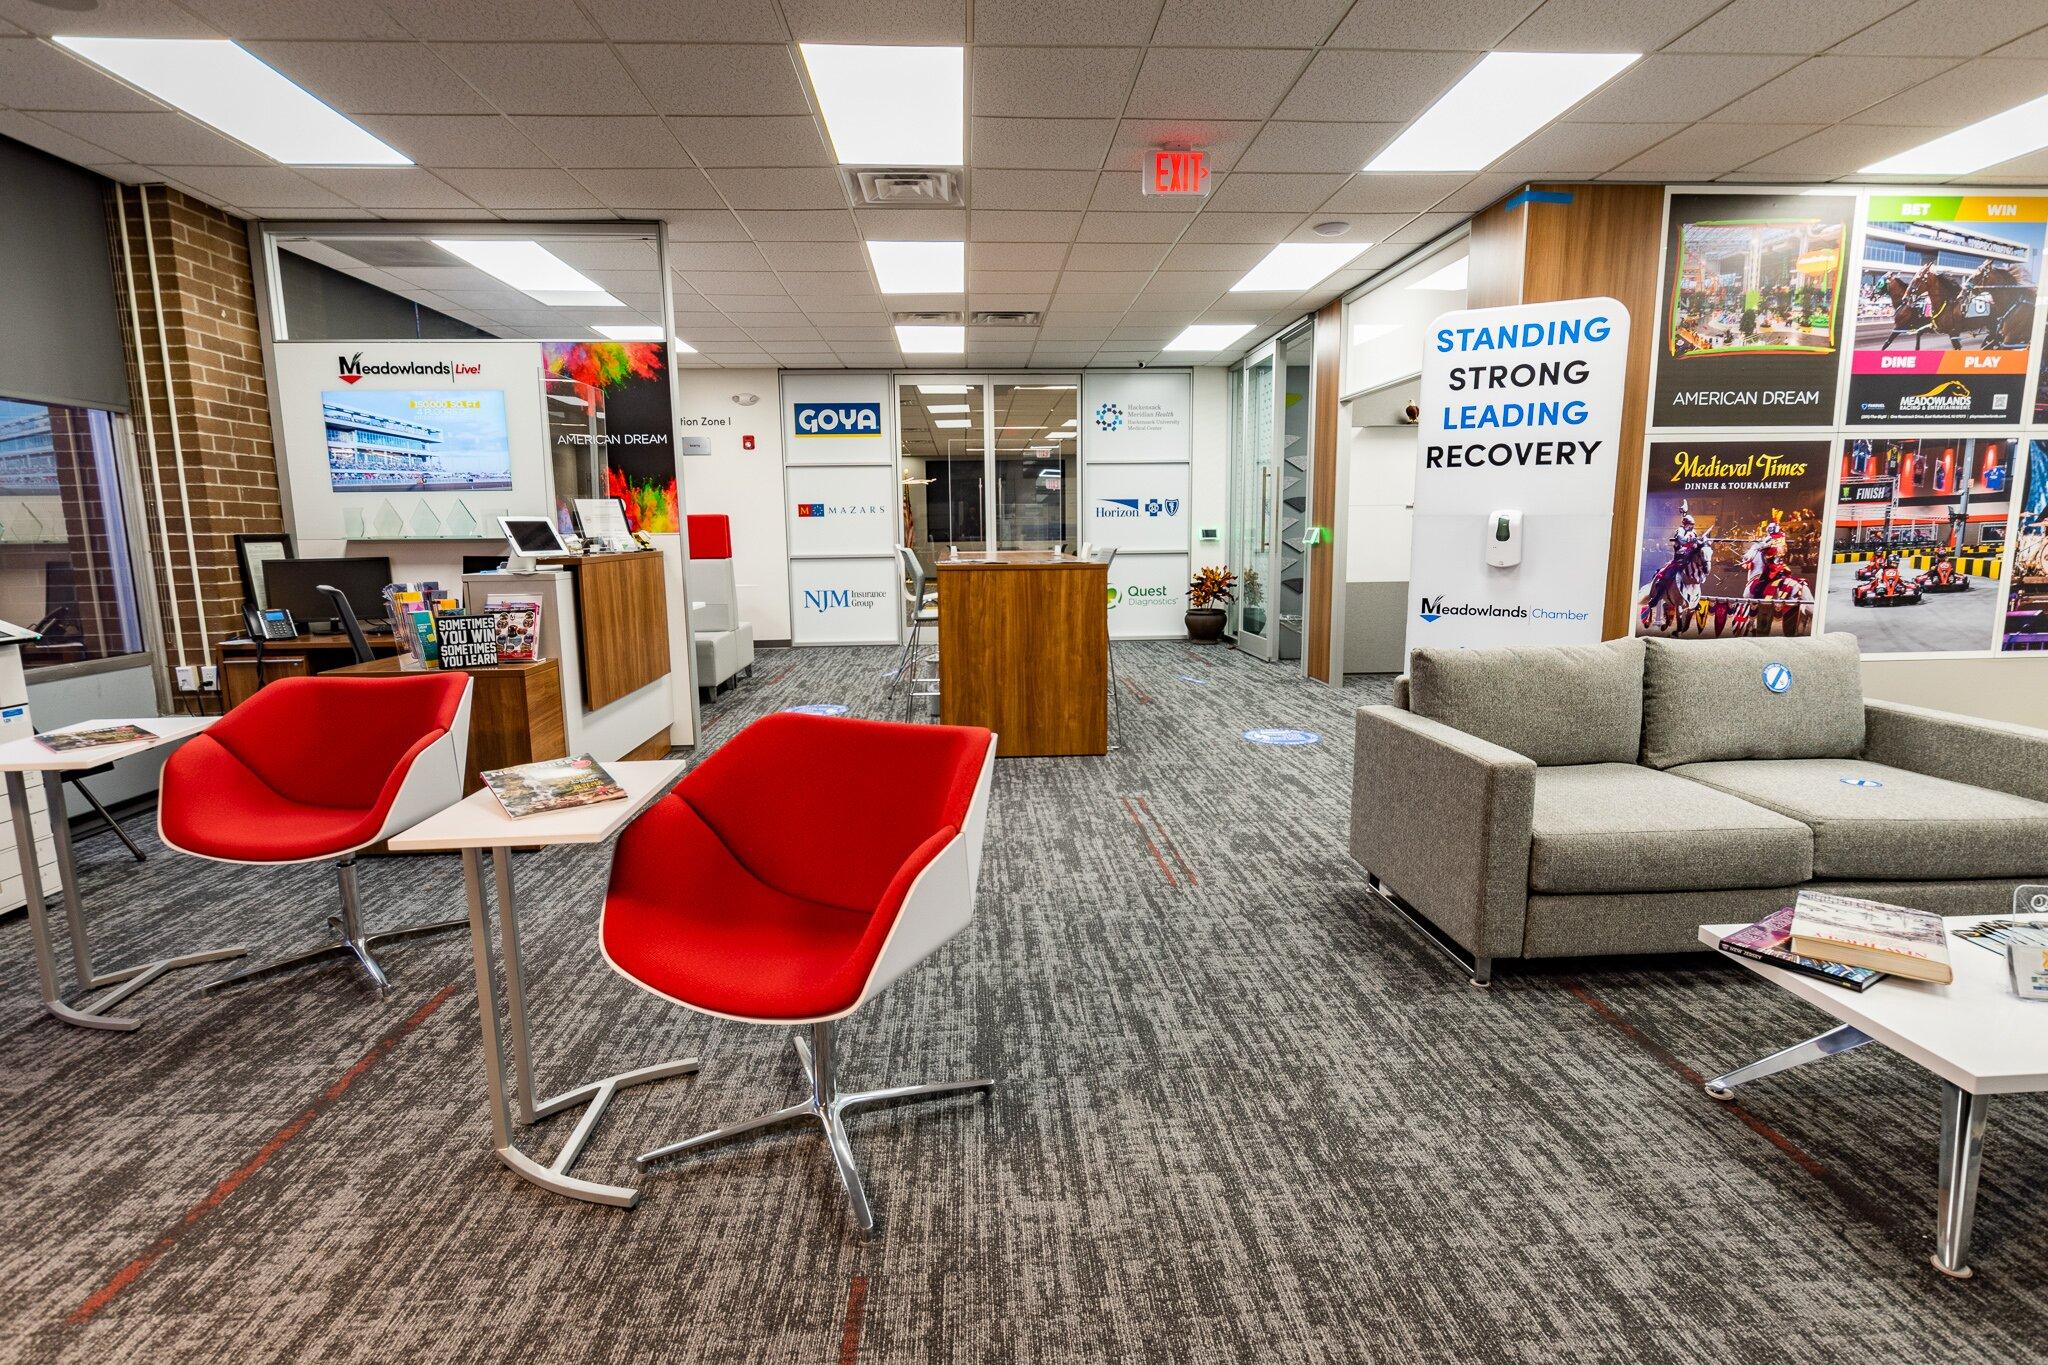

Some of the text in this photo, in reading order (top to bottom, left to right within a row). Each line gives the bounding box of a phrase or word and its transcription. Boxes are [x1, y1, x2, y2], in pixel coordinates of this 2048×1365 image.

[1155, 153, 1203, 192] EXIT
[1901, 203, 1931, 216] BET
[1987, 204, 2017, 216] WIN
[1437, 316, 1611, 353] STANDING
[339, 353, 481, 375] Meadowlands Live!
[1881, 356, 1917, 368] DINE
[1964, 356, 2001, 368] PLAY
[1449, 359, 1590, 391] STRONG
[1673, 390, 1820, 405] AMERICAN DREAM
[1900, 396, 1971, 406] MEADOWLANDS
[701, 416, 726, 426] Zone
[799, 408, 877, 433] GOYA
[1443, 400, 1588, 430] LEADING
[557, 434, 667, 445] AMERICAN DREAM
[1426, 440, 1603, 469] RECOVERY
[1670, 452, 1808, 482] Medieval Times
[1684, 481, 1790, 490] DINNER & TOURNAMENT
[1856, 487, 1885, 499] FINISH
[828, 506, 885, 515] MAZARS
[1096, 507, 1139, 518] Horizon
[1128, 585, 1167, 597] Quest
[804, 589, 887, 613] NJM Insurance
[851, 599, 874, 609] Group
[1128, 597, 1177, 607] Diagnostics
[1421, 595, 1589, 621] Meadowlands Chamber
[439, 617, 495, 631] SOMETIMES
[440, 628, 496, 645] YOU WIN
[441, 642, 497, 656] SOMETIMES
[442, 653, 498, 667] YOU LEARN
